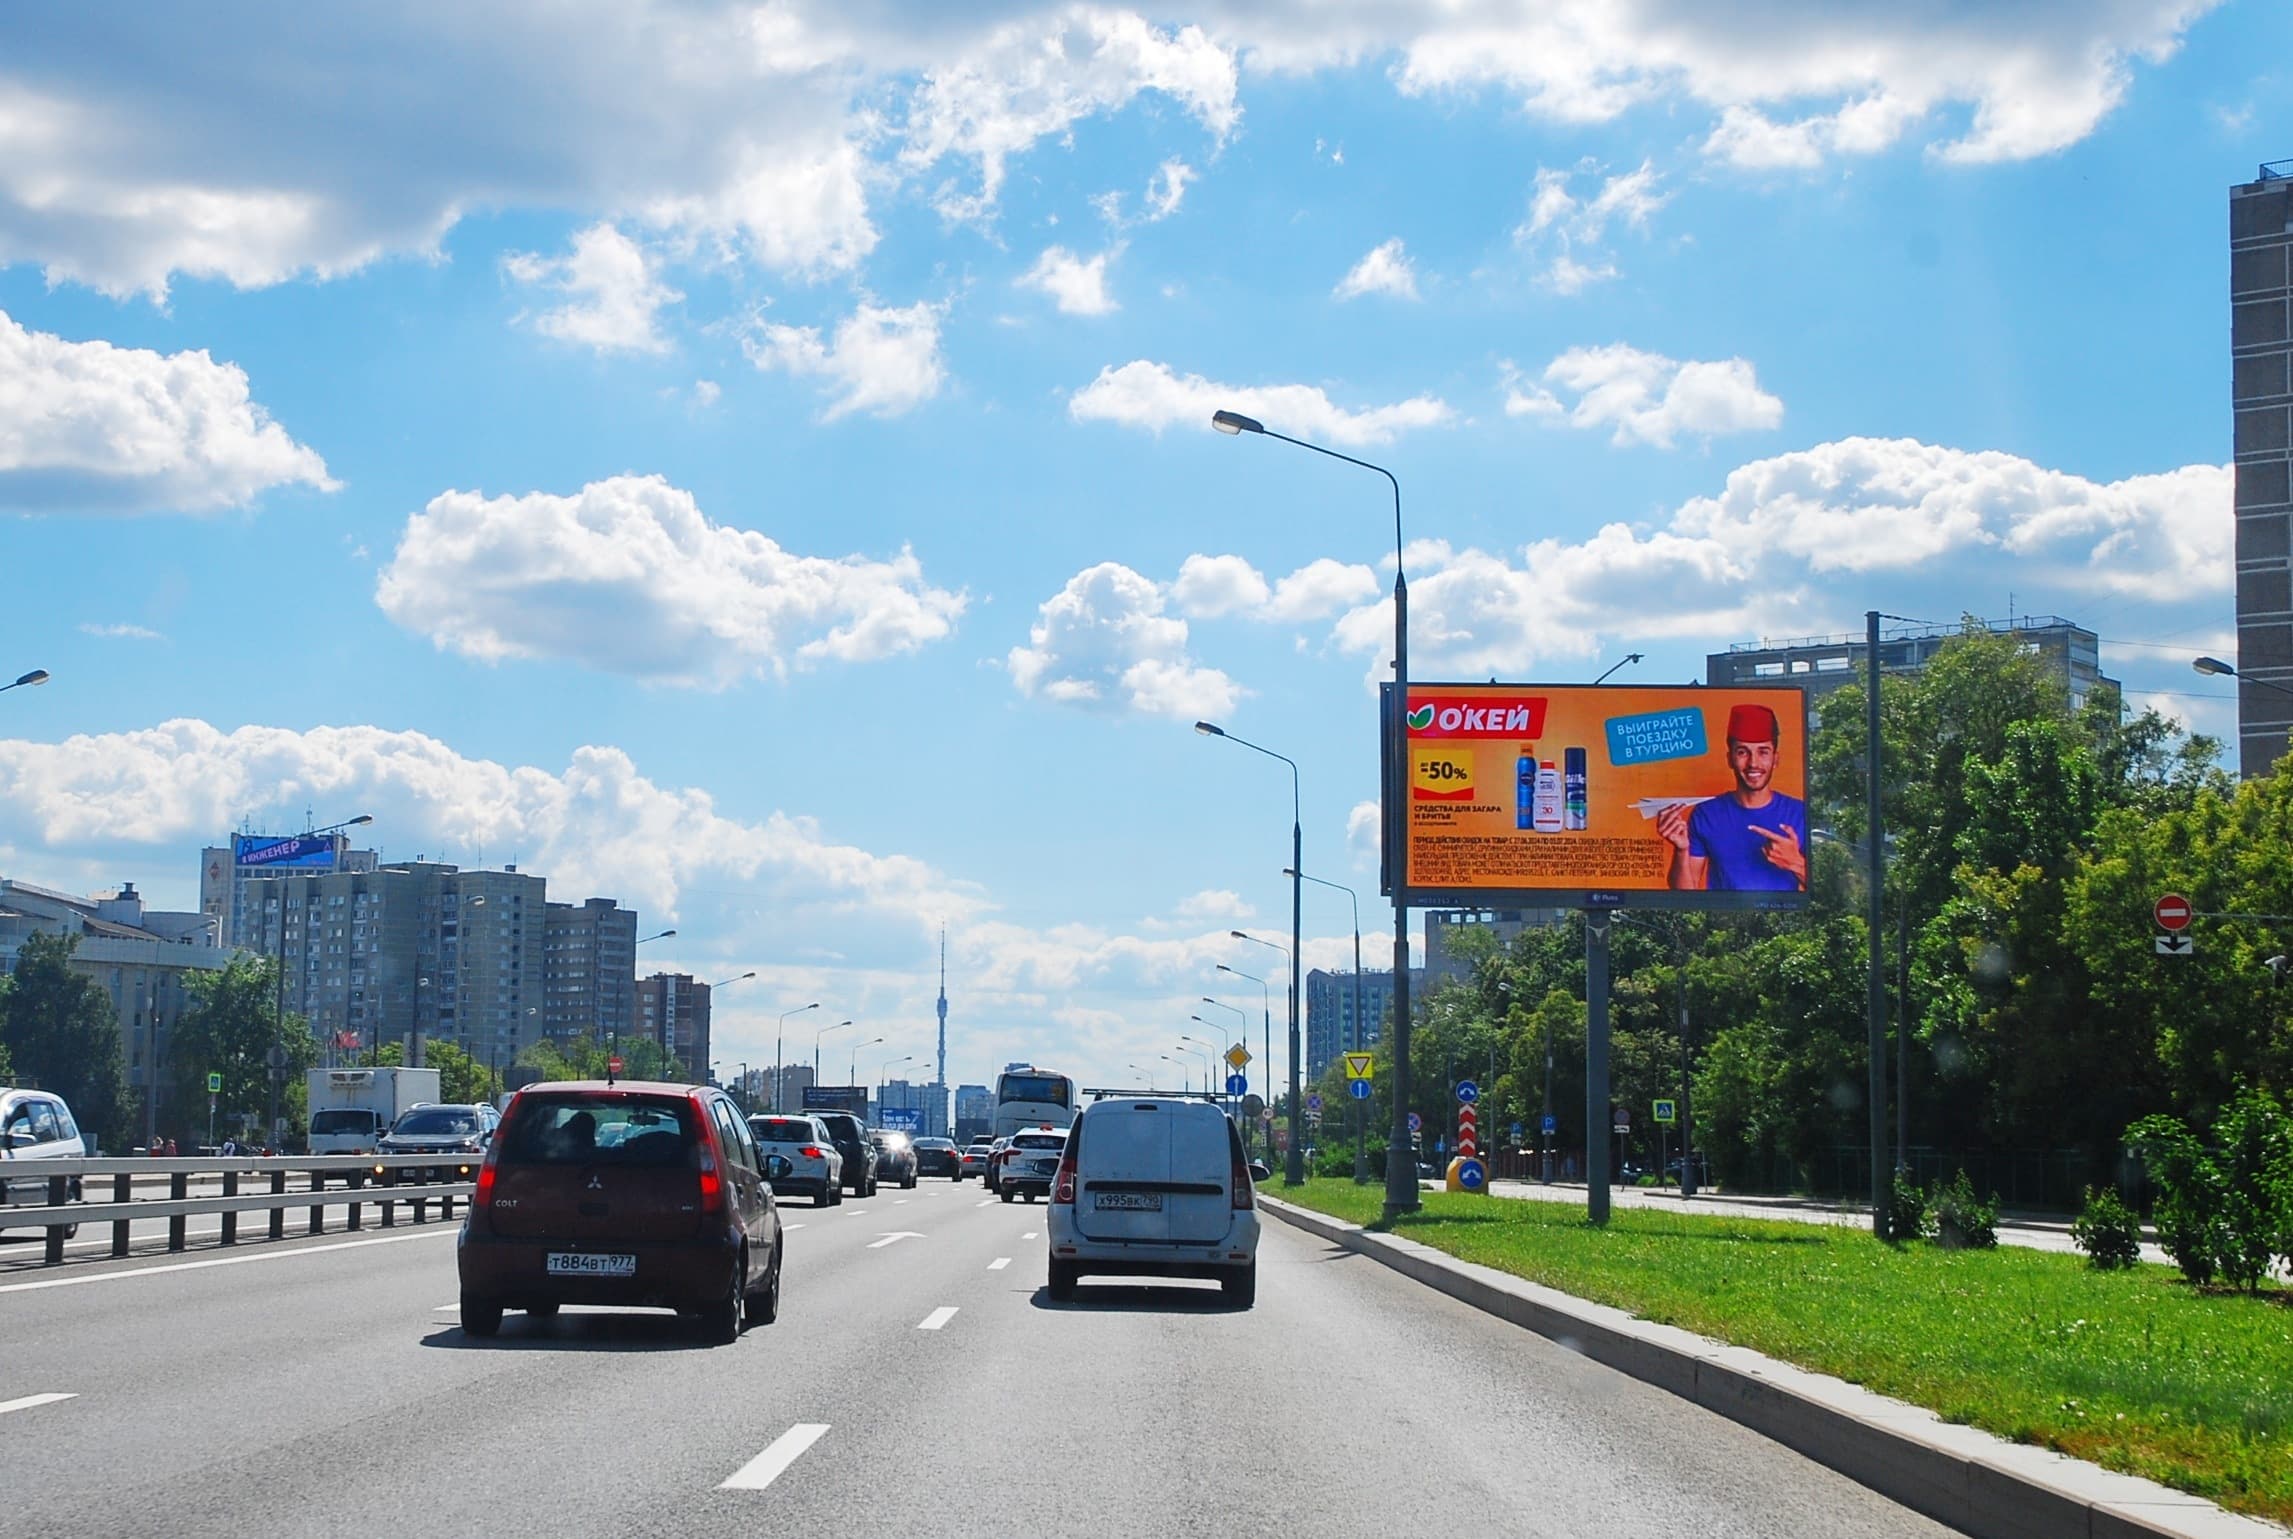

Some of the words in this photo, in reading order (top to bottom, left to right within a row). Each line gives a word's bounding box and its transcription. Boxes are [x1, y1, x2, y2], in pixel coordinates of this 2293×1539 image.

[1617, 715, 1694, 735] ВЫИГРАЙТЕ
[1626, 728, 1688, 746] ПОЕЗДКУ
[1625, 747, 1633, 758] В
[1634, 739, 1694, 756] ТУРЦИЮ
[1414, 805, 1453, 813] СРЕДСТВА
[1455, 805, 1471, 813] ДЛЯ
[1472, 805, 1502, 813] ЗАГАРА
[247, 840, 301, 862] ИНЖЕНЕР
[495, 1199, 518, 1208] COLT
[610, 1255, 633, 1267] 977
